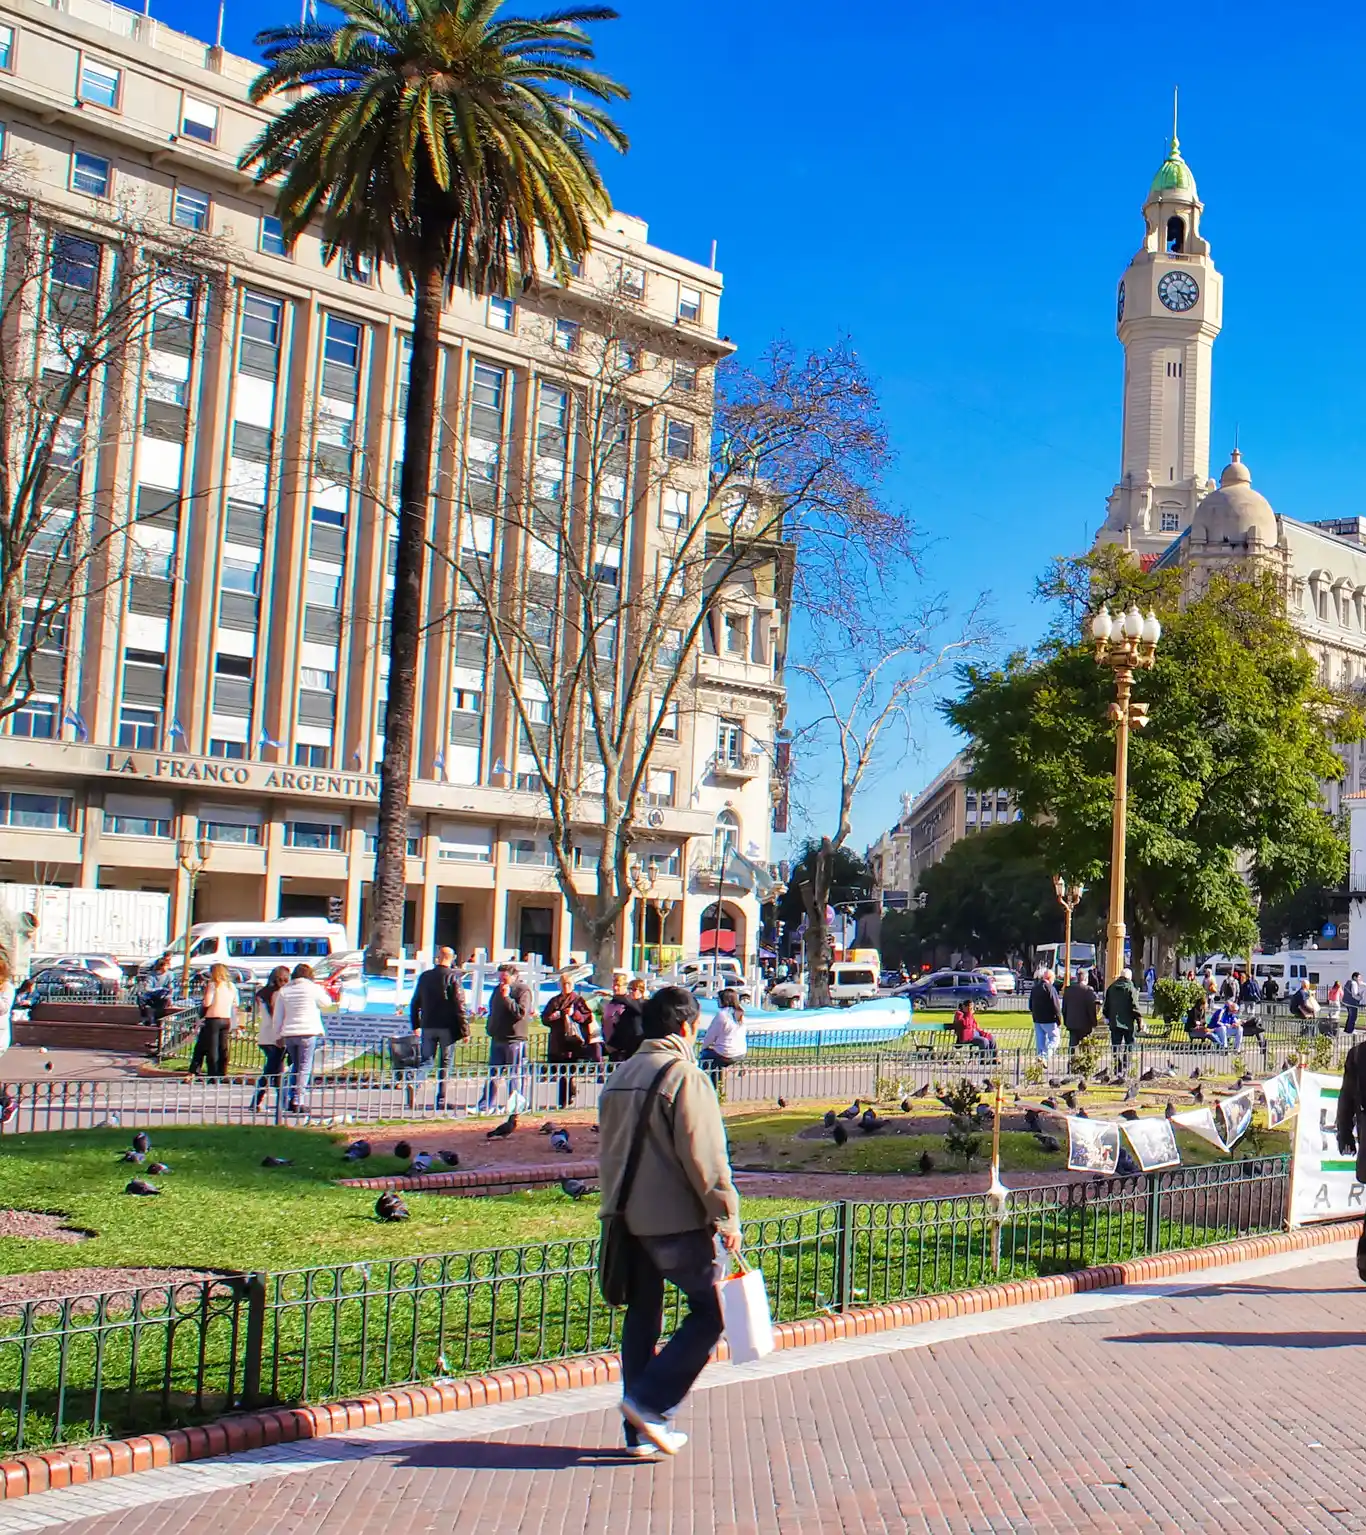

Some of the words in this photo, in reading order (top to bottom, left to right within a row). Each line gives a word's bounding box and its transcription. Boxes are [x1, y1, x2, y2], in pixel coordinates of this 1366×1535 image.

[106, 754, 137, 774] LA
[155, 759, 249, 784] FRANCO
[265, 771, 380, 797] ARGENTIN
